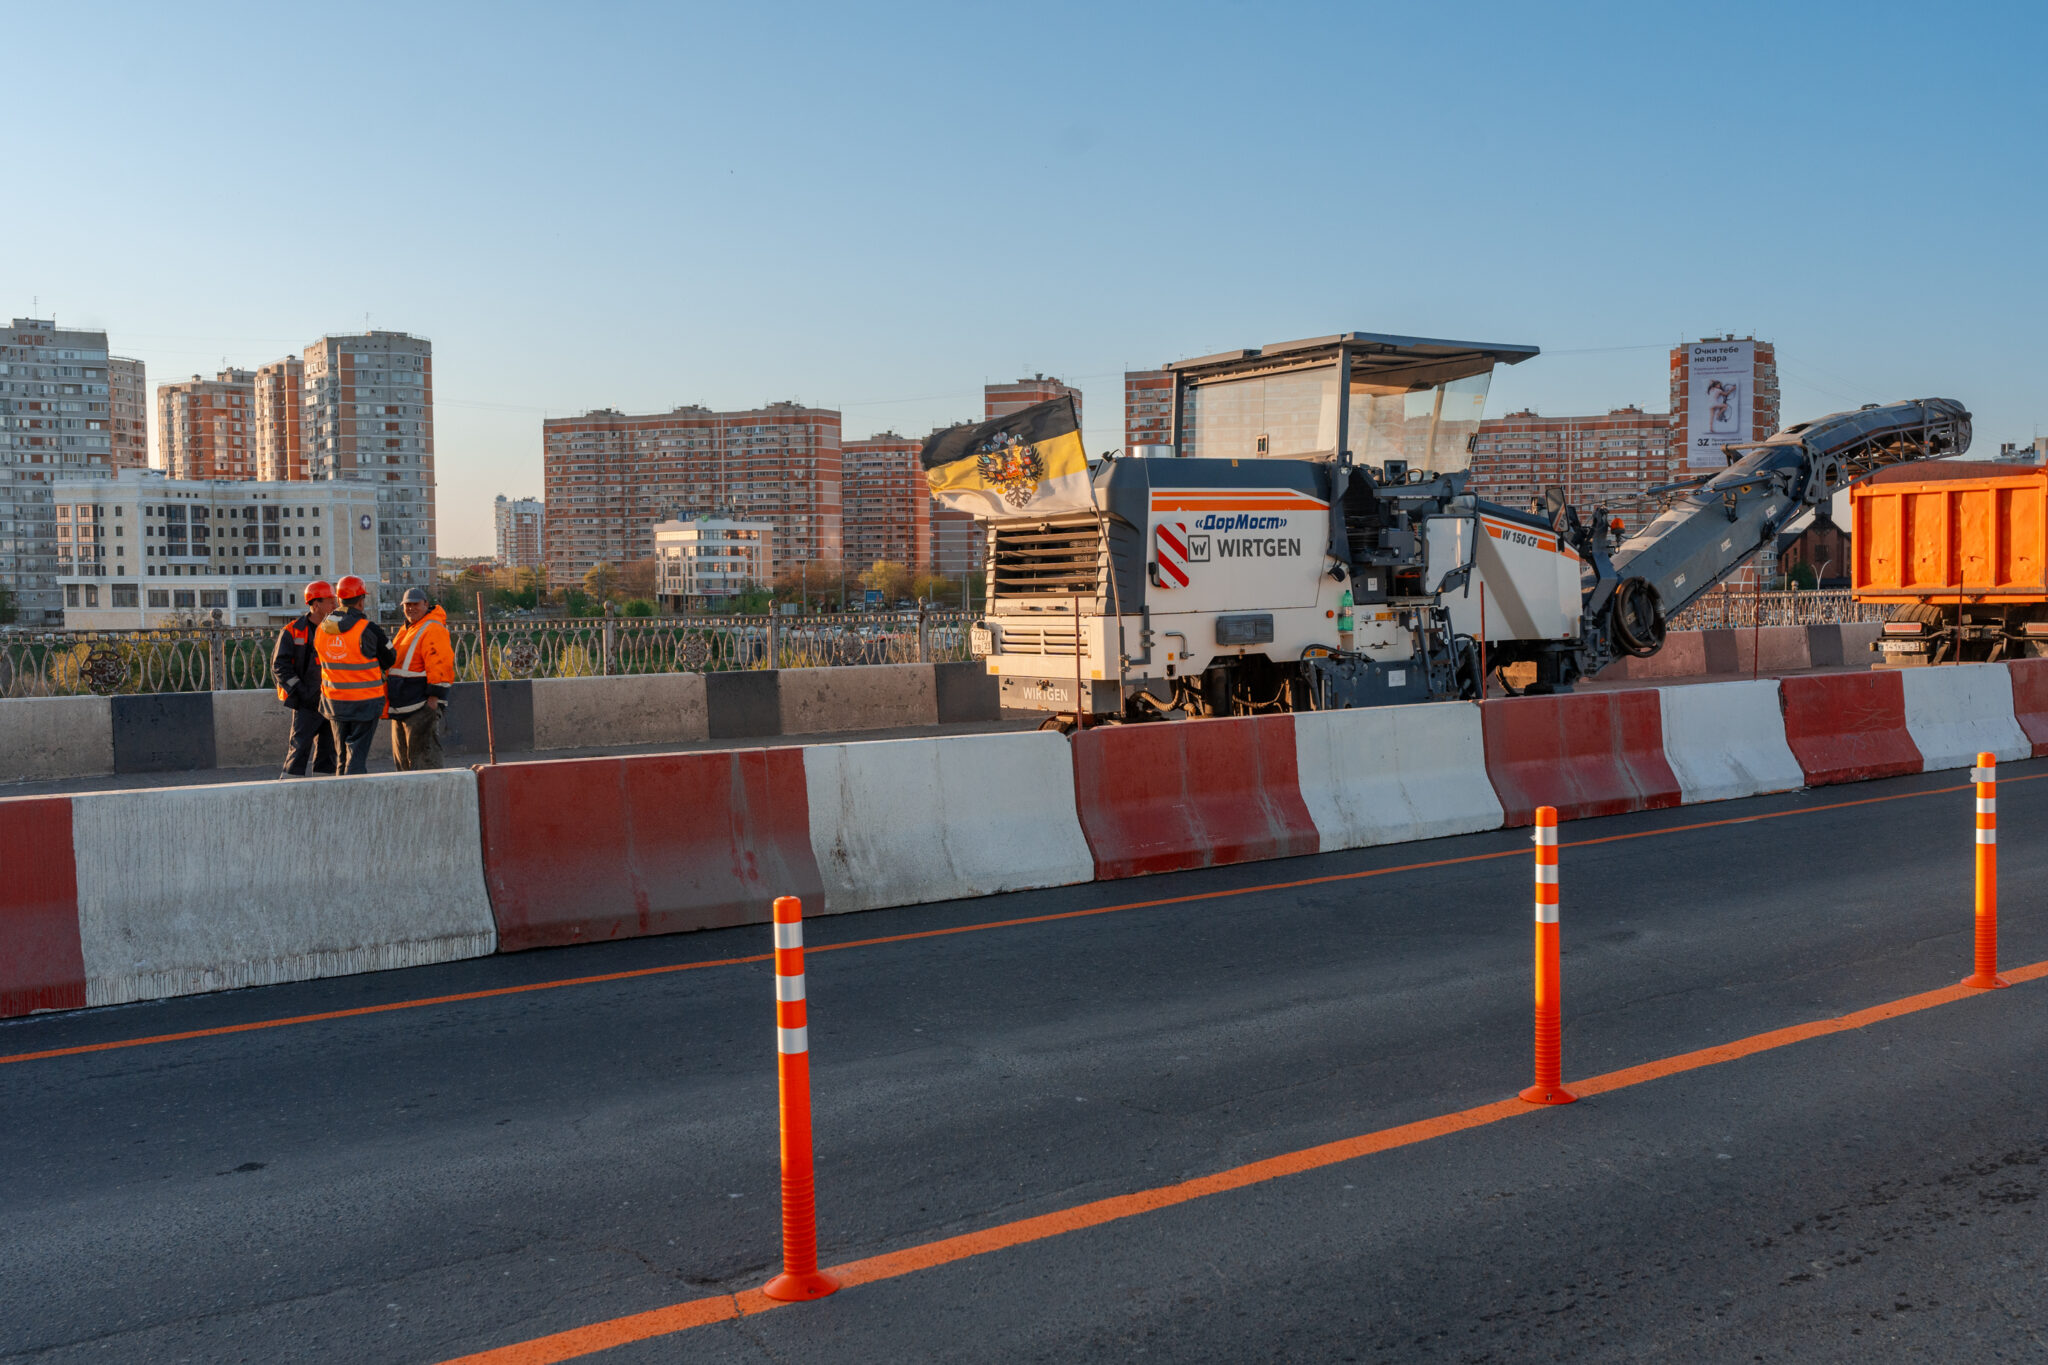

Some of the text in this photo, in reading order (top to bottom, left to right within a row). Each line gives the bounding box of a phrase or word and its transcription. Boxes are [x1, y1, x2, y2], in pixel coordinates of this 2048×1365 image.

[1694, 346, 1739, 355] Очки тебе
[1706, 355, 1727, 363] пара
[1697, 438, 1710, 447] 3Z
[1195, 514, 1288, 533] «ДорМост»
[1502, 529, 1538, 547] W 150 CF
[1217, 538, 1301, 557] WIRTGEN
[1023, 686, 1068, 702] WIRTGEN
